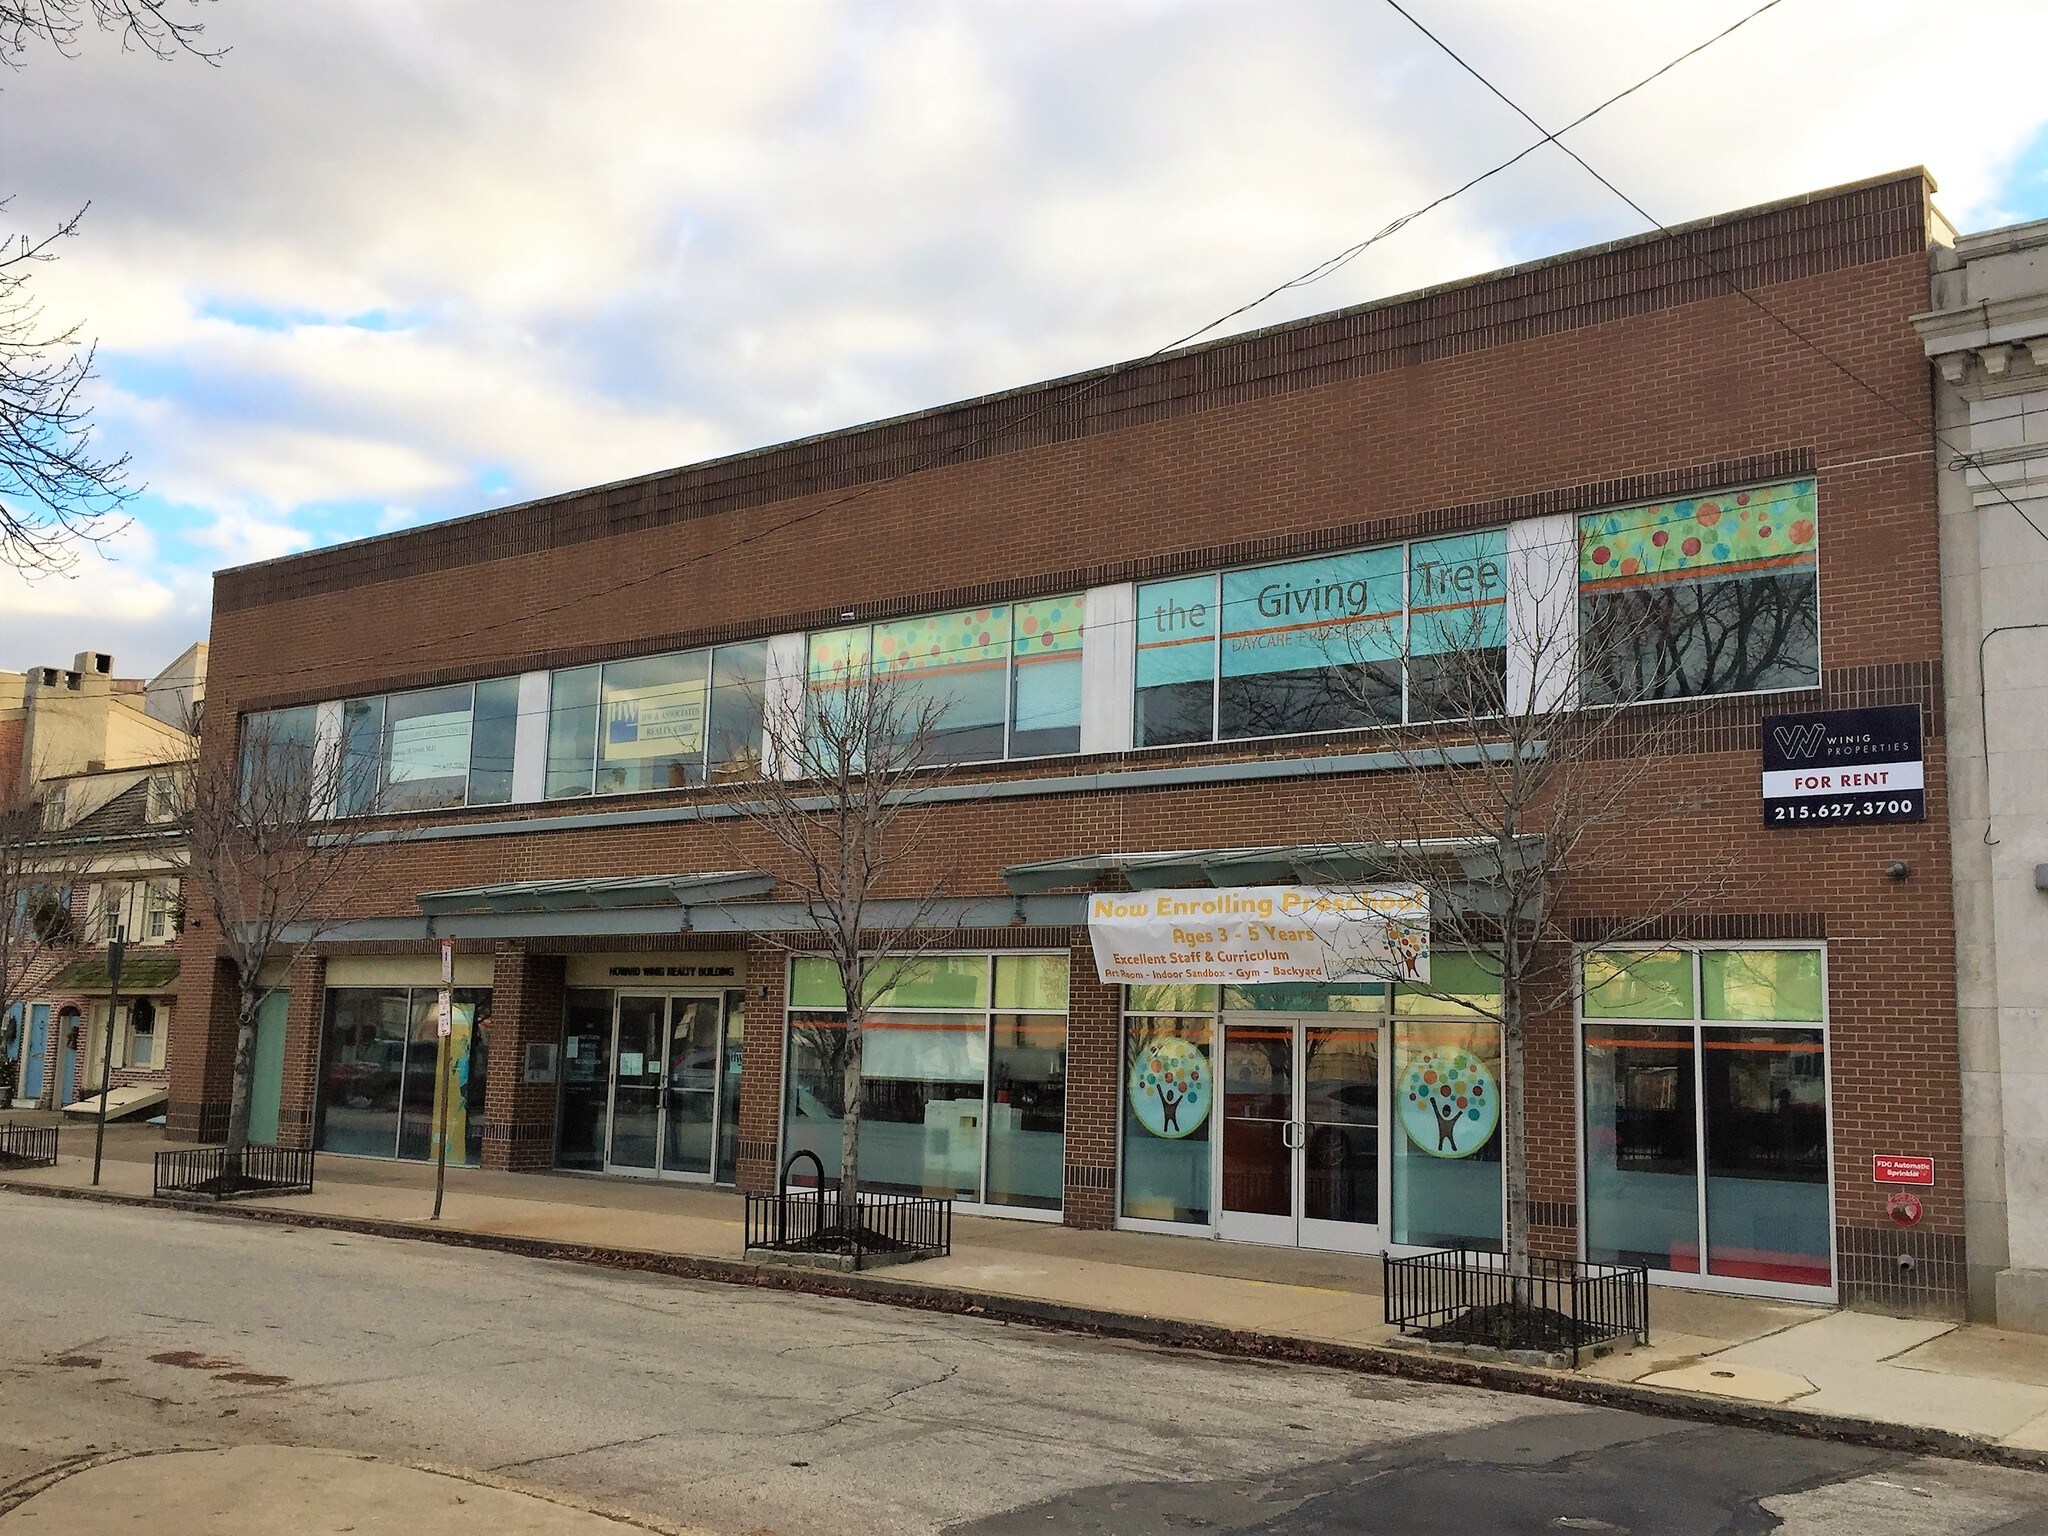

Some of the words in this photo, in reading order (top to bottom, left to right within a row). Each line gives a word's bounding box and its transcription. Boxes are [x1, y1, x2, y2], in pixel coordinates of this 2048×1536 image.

[1154, 598, 1206, 633] the
[1257, 578, 1369, 617] Giving
[1416, 559, 1499, 597] Tree
[1231, 633, 1293, 653] DAYCARE
[1826, 734, 1872, 744] WINIG
[1827, 742, 1909, 756] PROPERTIES
[1794, 776, 1832, 790] FOR
[1840, 771, 1889, 788] RENT
[1774, 799, 1913, 820] 215.627.3700
[1094, 899, 1149, 919] Now
[1156, 892, 1274, 919] Enrolling
[1282, 888, 1425, 913] Preschool
[1172, 927, 1214, 948] Ages
[1217, 926, 1229, 943] 3
[1247, 925, 1260, 942] 5
[1264, 925, 1316, 942] Years
[1112, 952, 1167, 965] Excellent
[1169, 951, 1201, 964] Staff
[1204, 950, 1214, 963] &
[1217, 949, 1290, 963] Curriculum
[1105, 968, 1120, 978] Art
[1120, 969, 1144, 979] Room
[1152, 970, 1183, 979] Indoor
[1185, 968, 1226, 978] Sandbox
[1235, 968, 1261, 981] Gym
[1272, 965, 1323, 978] Backyard
[1893, 1162, 1930, 1170] Automatic
